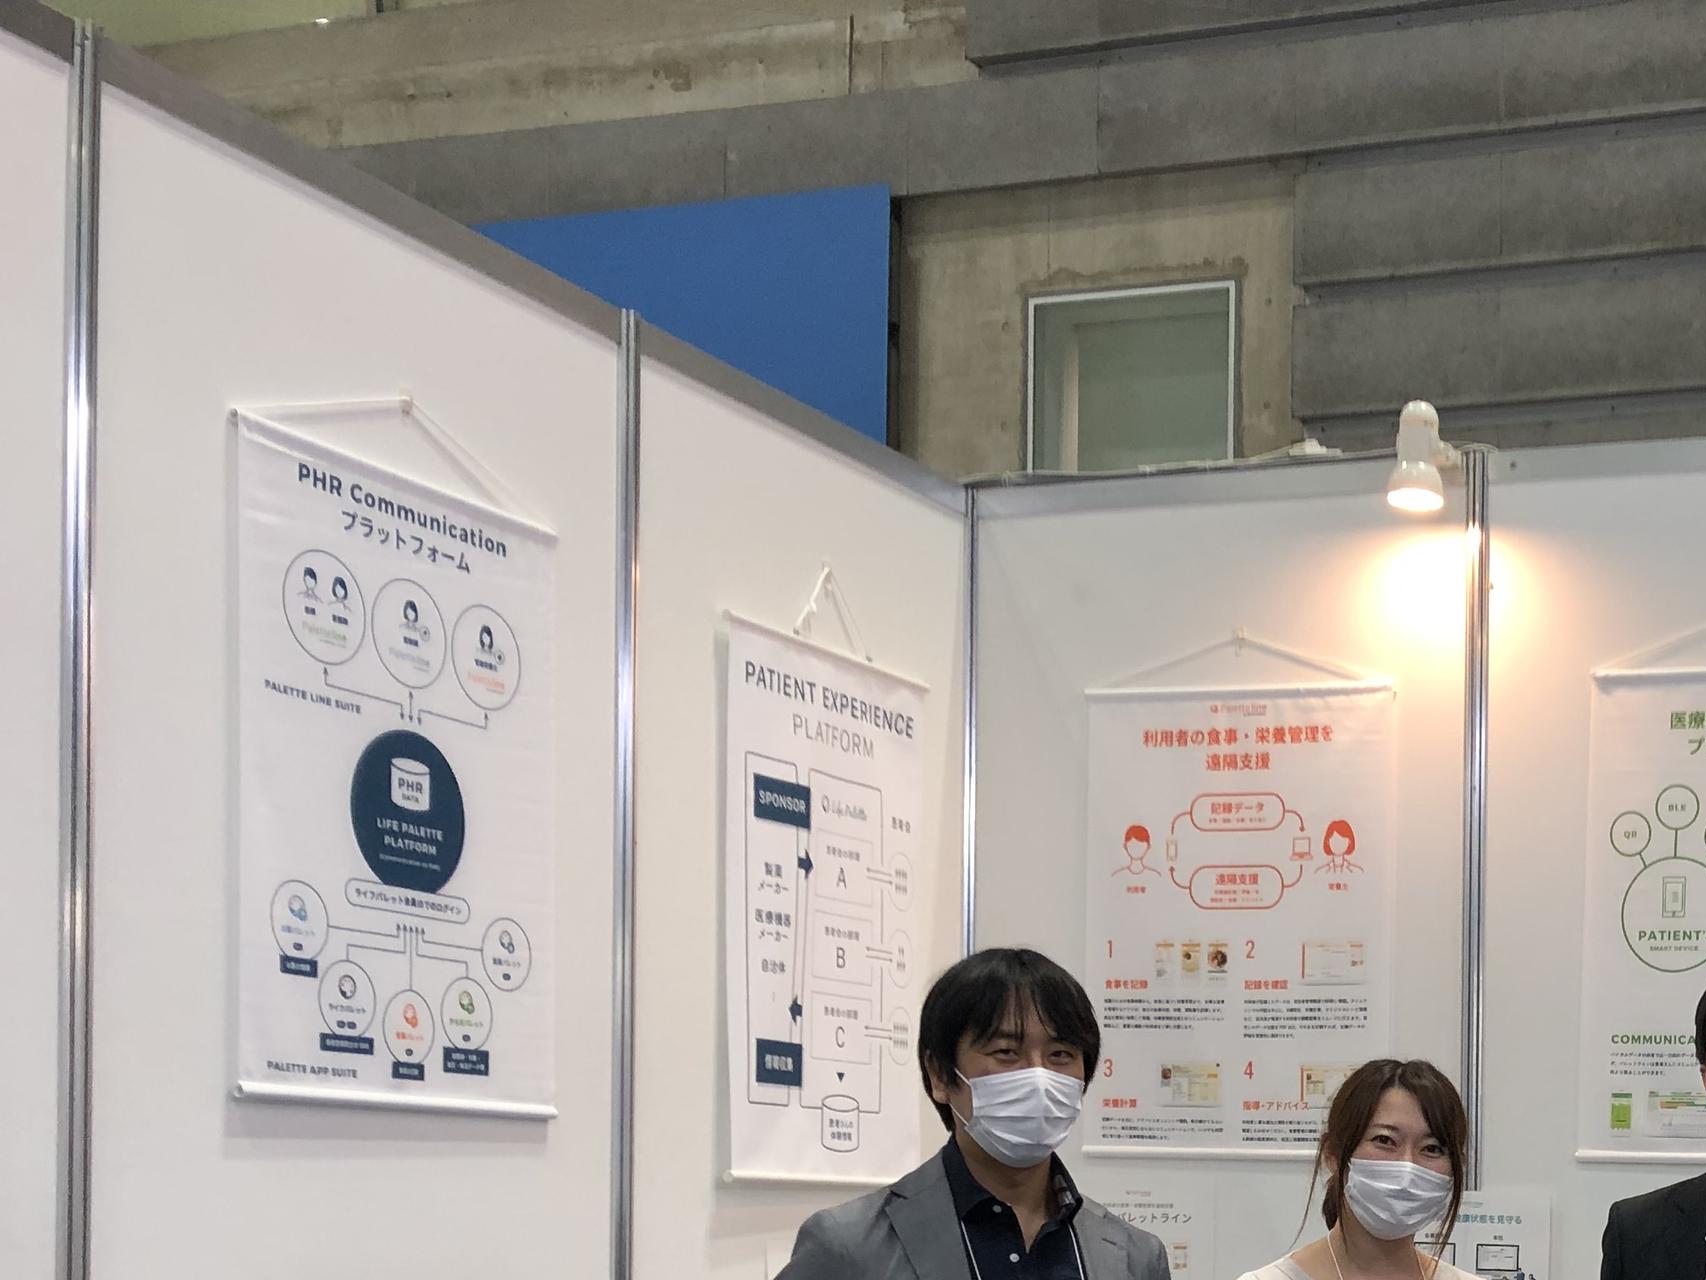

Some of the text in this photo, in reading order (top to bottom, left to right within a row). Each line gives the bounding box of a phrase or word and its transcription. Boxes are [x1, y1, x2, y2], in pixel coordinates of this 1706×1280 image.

[298, 462, 507, 558] PHR Communication
[341, 510, 470, 574] プラットフォーム
[264, 679, 361, 714] PALETTE LINE SUITE
[745, 660, 914, 739] PATIENT EXPERIENCE
[792, 713, 874, 759] PLATFORM
[1143, 725, 1334, 748] 利用者の食事・栄養管理を
[1205, 752, 1271, 771] 遠隔支援
[398, 778, 423, 793] PHR
[759, 790, 806, 815] SPONSOR
[1210, 802, 1265, 815] 記録データ
[377, 817, 443, 841] LIFE PALETTE
[384, 835, 437, 855] PLATFORM
[836, 867, 847, 889] A
[758, 882, 789, 895] メーカー
[758, 929, 789, 942] メーカー
[836, 947, 846, 968] B
[1107, 940, 1113, 958] 1
[1245, 940, 1255, 959] 2
[836, 1025, 846, 1048] C
[267, 1060, 358, 1079] PALETTE APP SUITE
[1103, 1059, 1113, 1078] 3
[1243, 1062, 1255, 1081] 4
